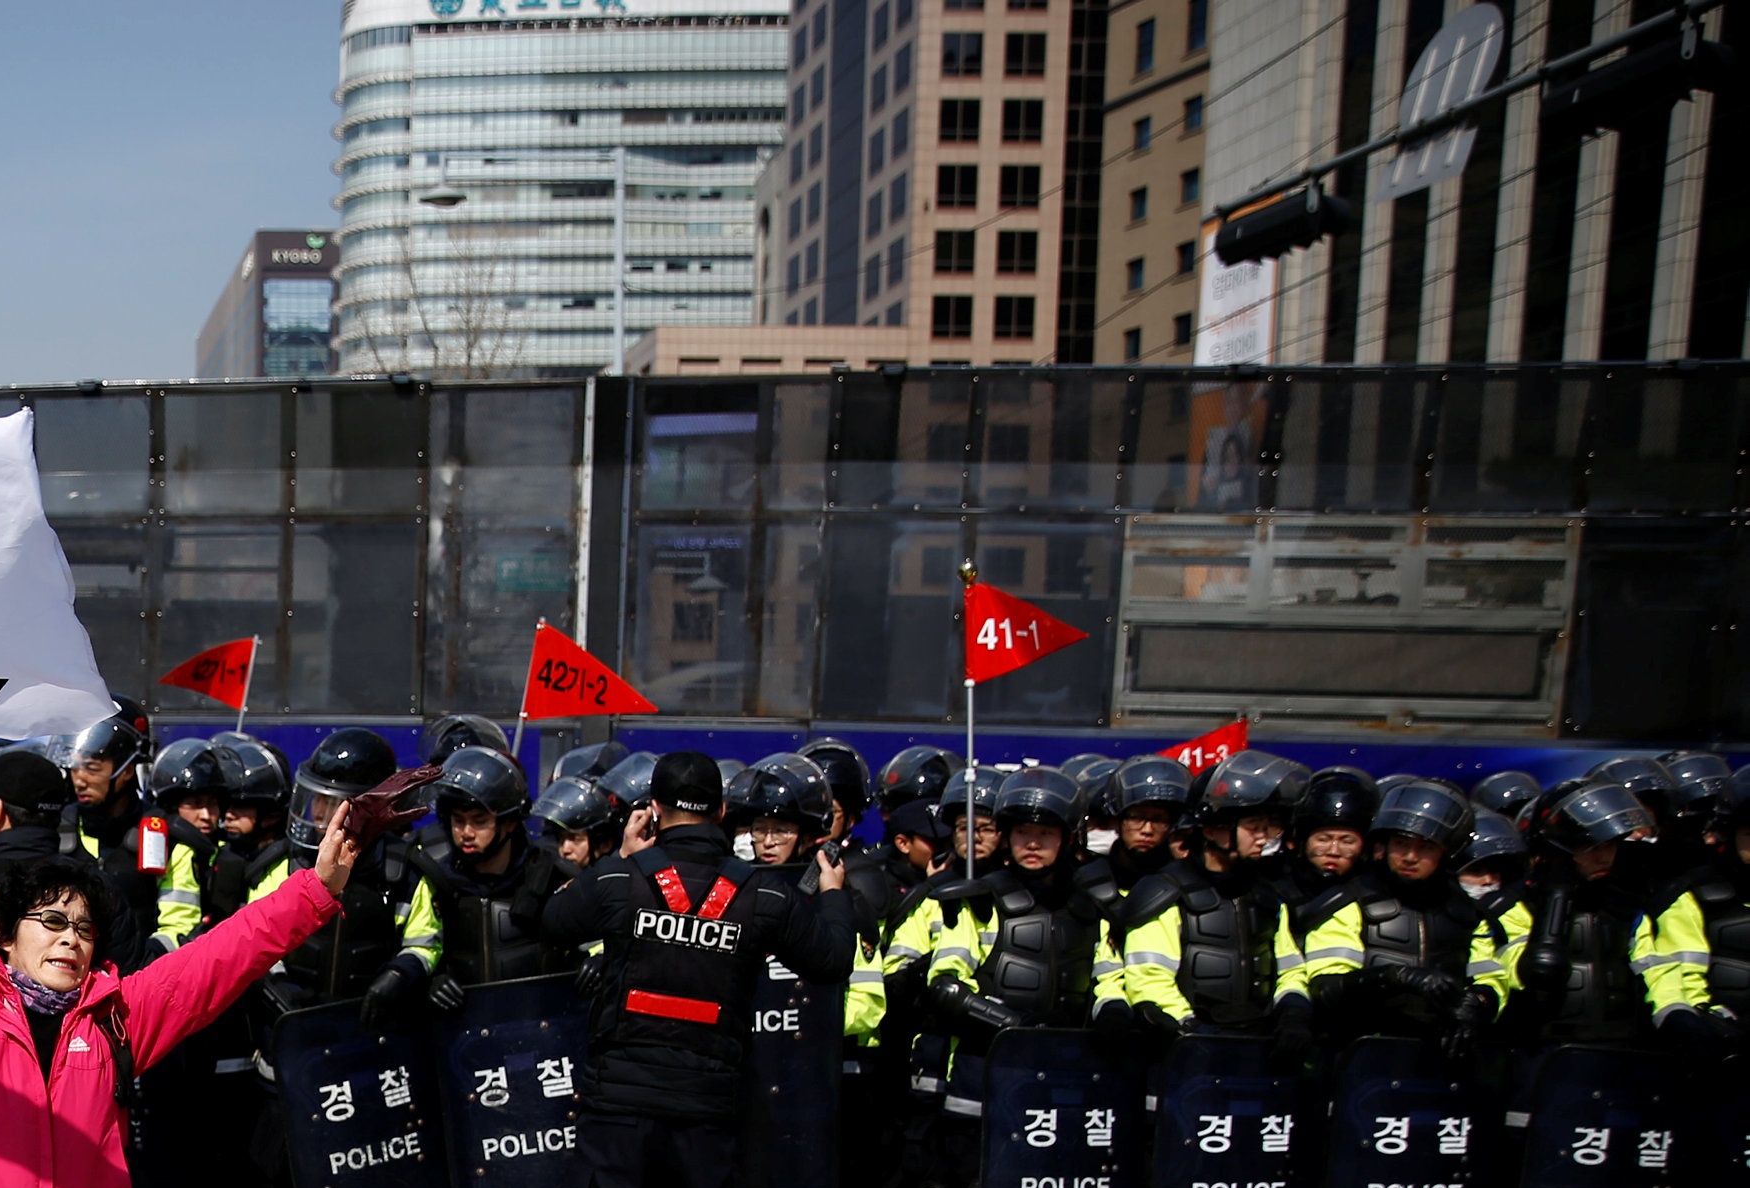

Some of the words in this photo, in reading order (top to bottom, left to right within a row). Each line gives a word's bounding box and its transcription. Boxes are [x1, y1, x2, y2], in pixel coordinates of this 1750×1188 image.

[272, 248, 322, 264] KYOBO
[976, 617, 1040, 651] 41-1
[1177, 744, 1230, 768] 41-3
[637, 911, 738, 950] POLICE
[751, 1008, 800, 1033] ICE
[329, 1131, 421, 1175] POLICE
[482, 1125, 577, 1161] POLICE
